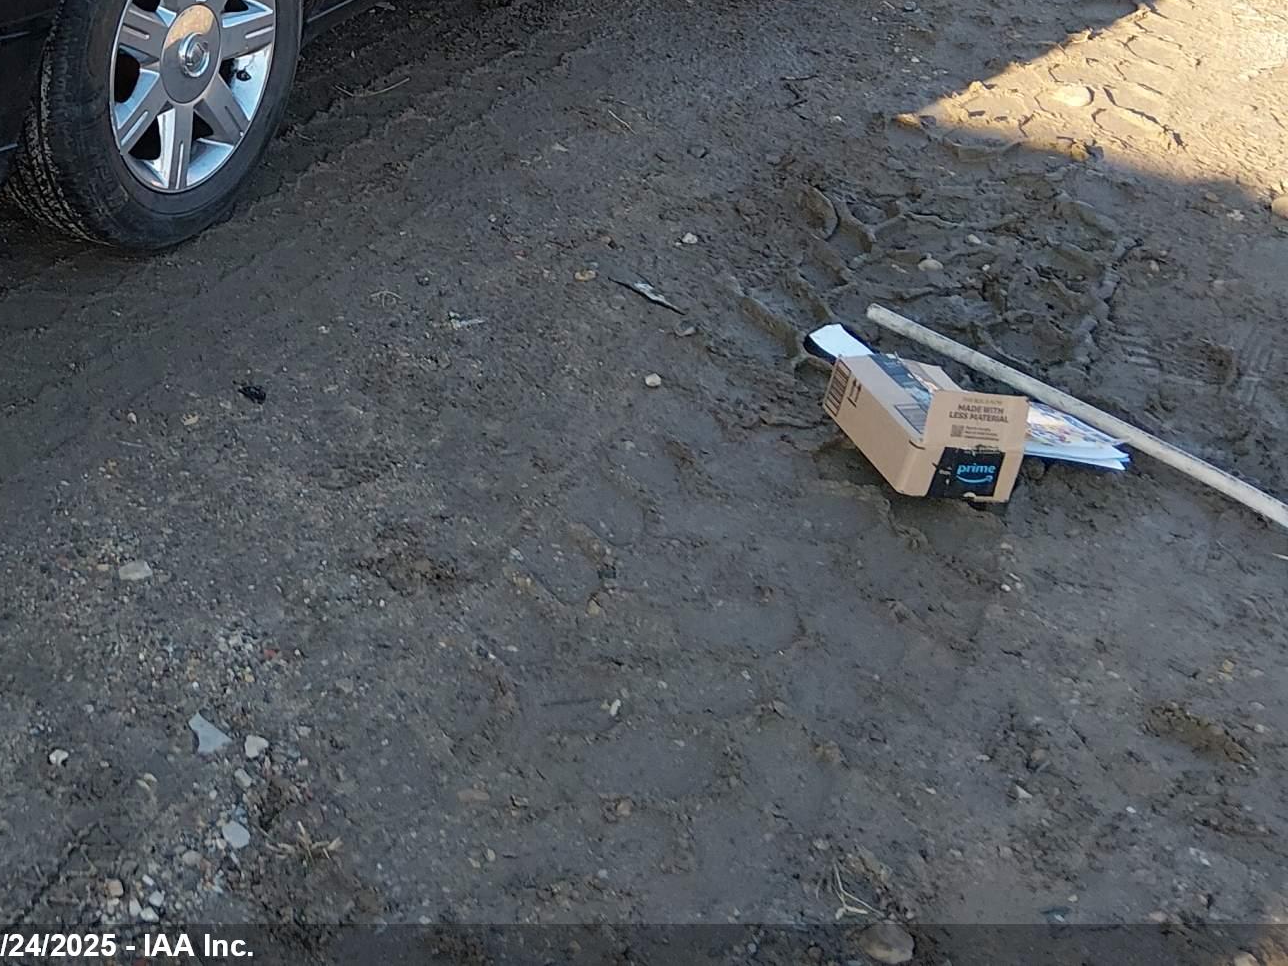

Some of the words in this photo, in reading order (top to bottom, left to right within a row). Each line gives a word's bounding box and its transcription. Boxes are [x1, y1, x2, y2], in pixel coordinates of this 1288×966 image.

[957, 403, 982, 414] MADE
[948, 411, 969, 420] LESS
[970, 412, 1009, 423] MATERIAL
[956, 463, 997, 475] prime
